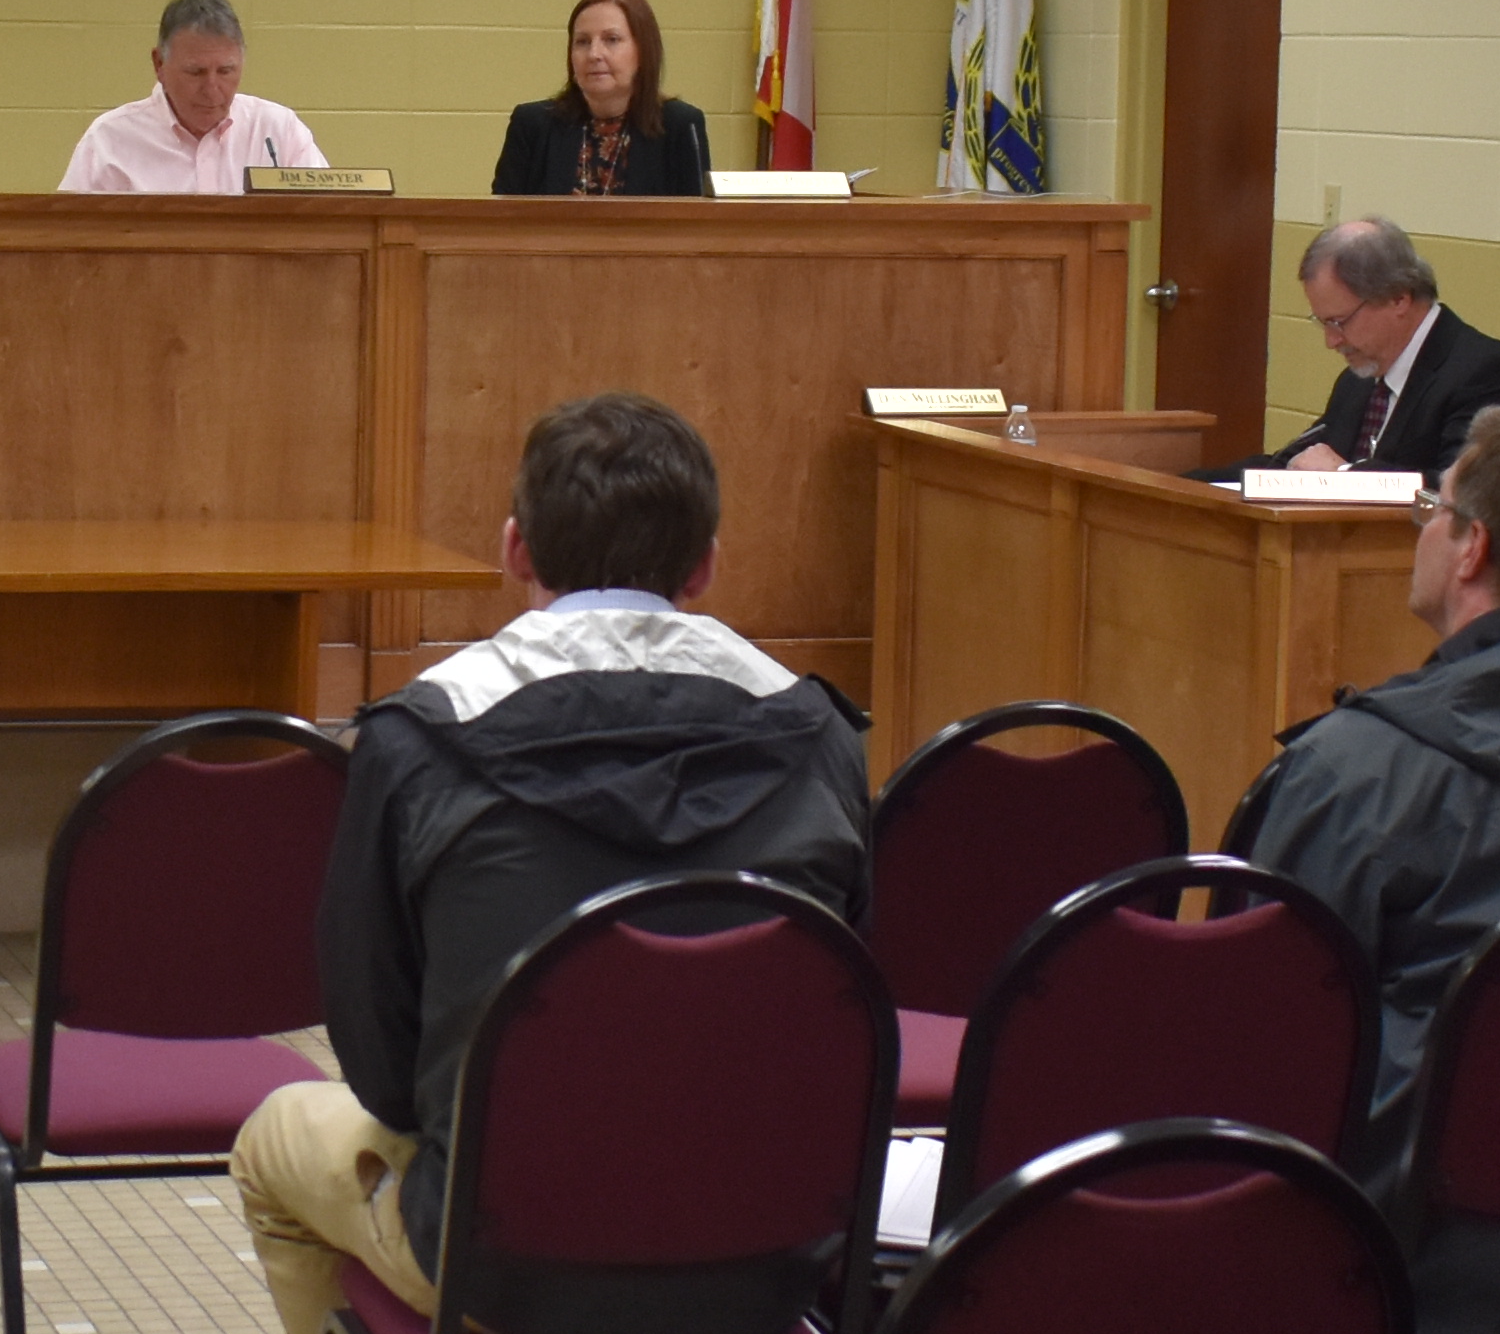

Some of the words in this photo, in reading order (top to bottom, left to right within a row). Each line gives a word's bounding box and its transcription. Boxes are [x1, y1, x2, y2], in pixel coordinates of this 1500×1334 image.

[278, 170, 300, 182] JIM
[305, 170, 364, 183] SAWYER
[911, 392, 999, 404] WILLINGHAM
